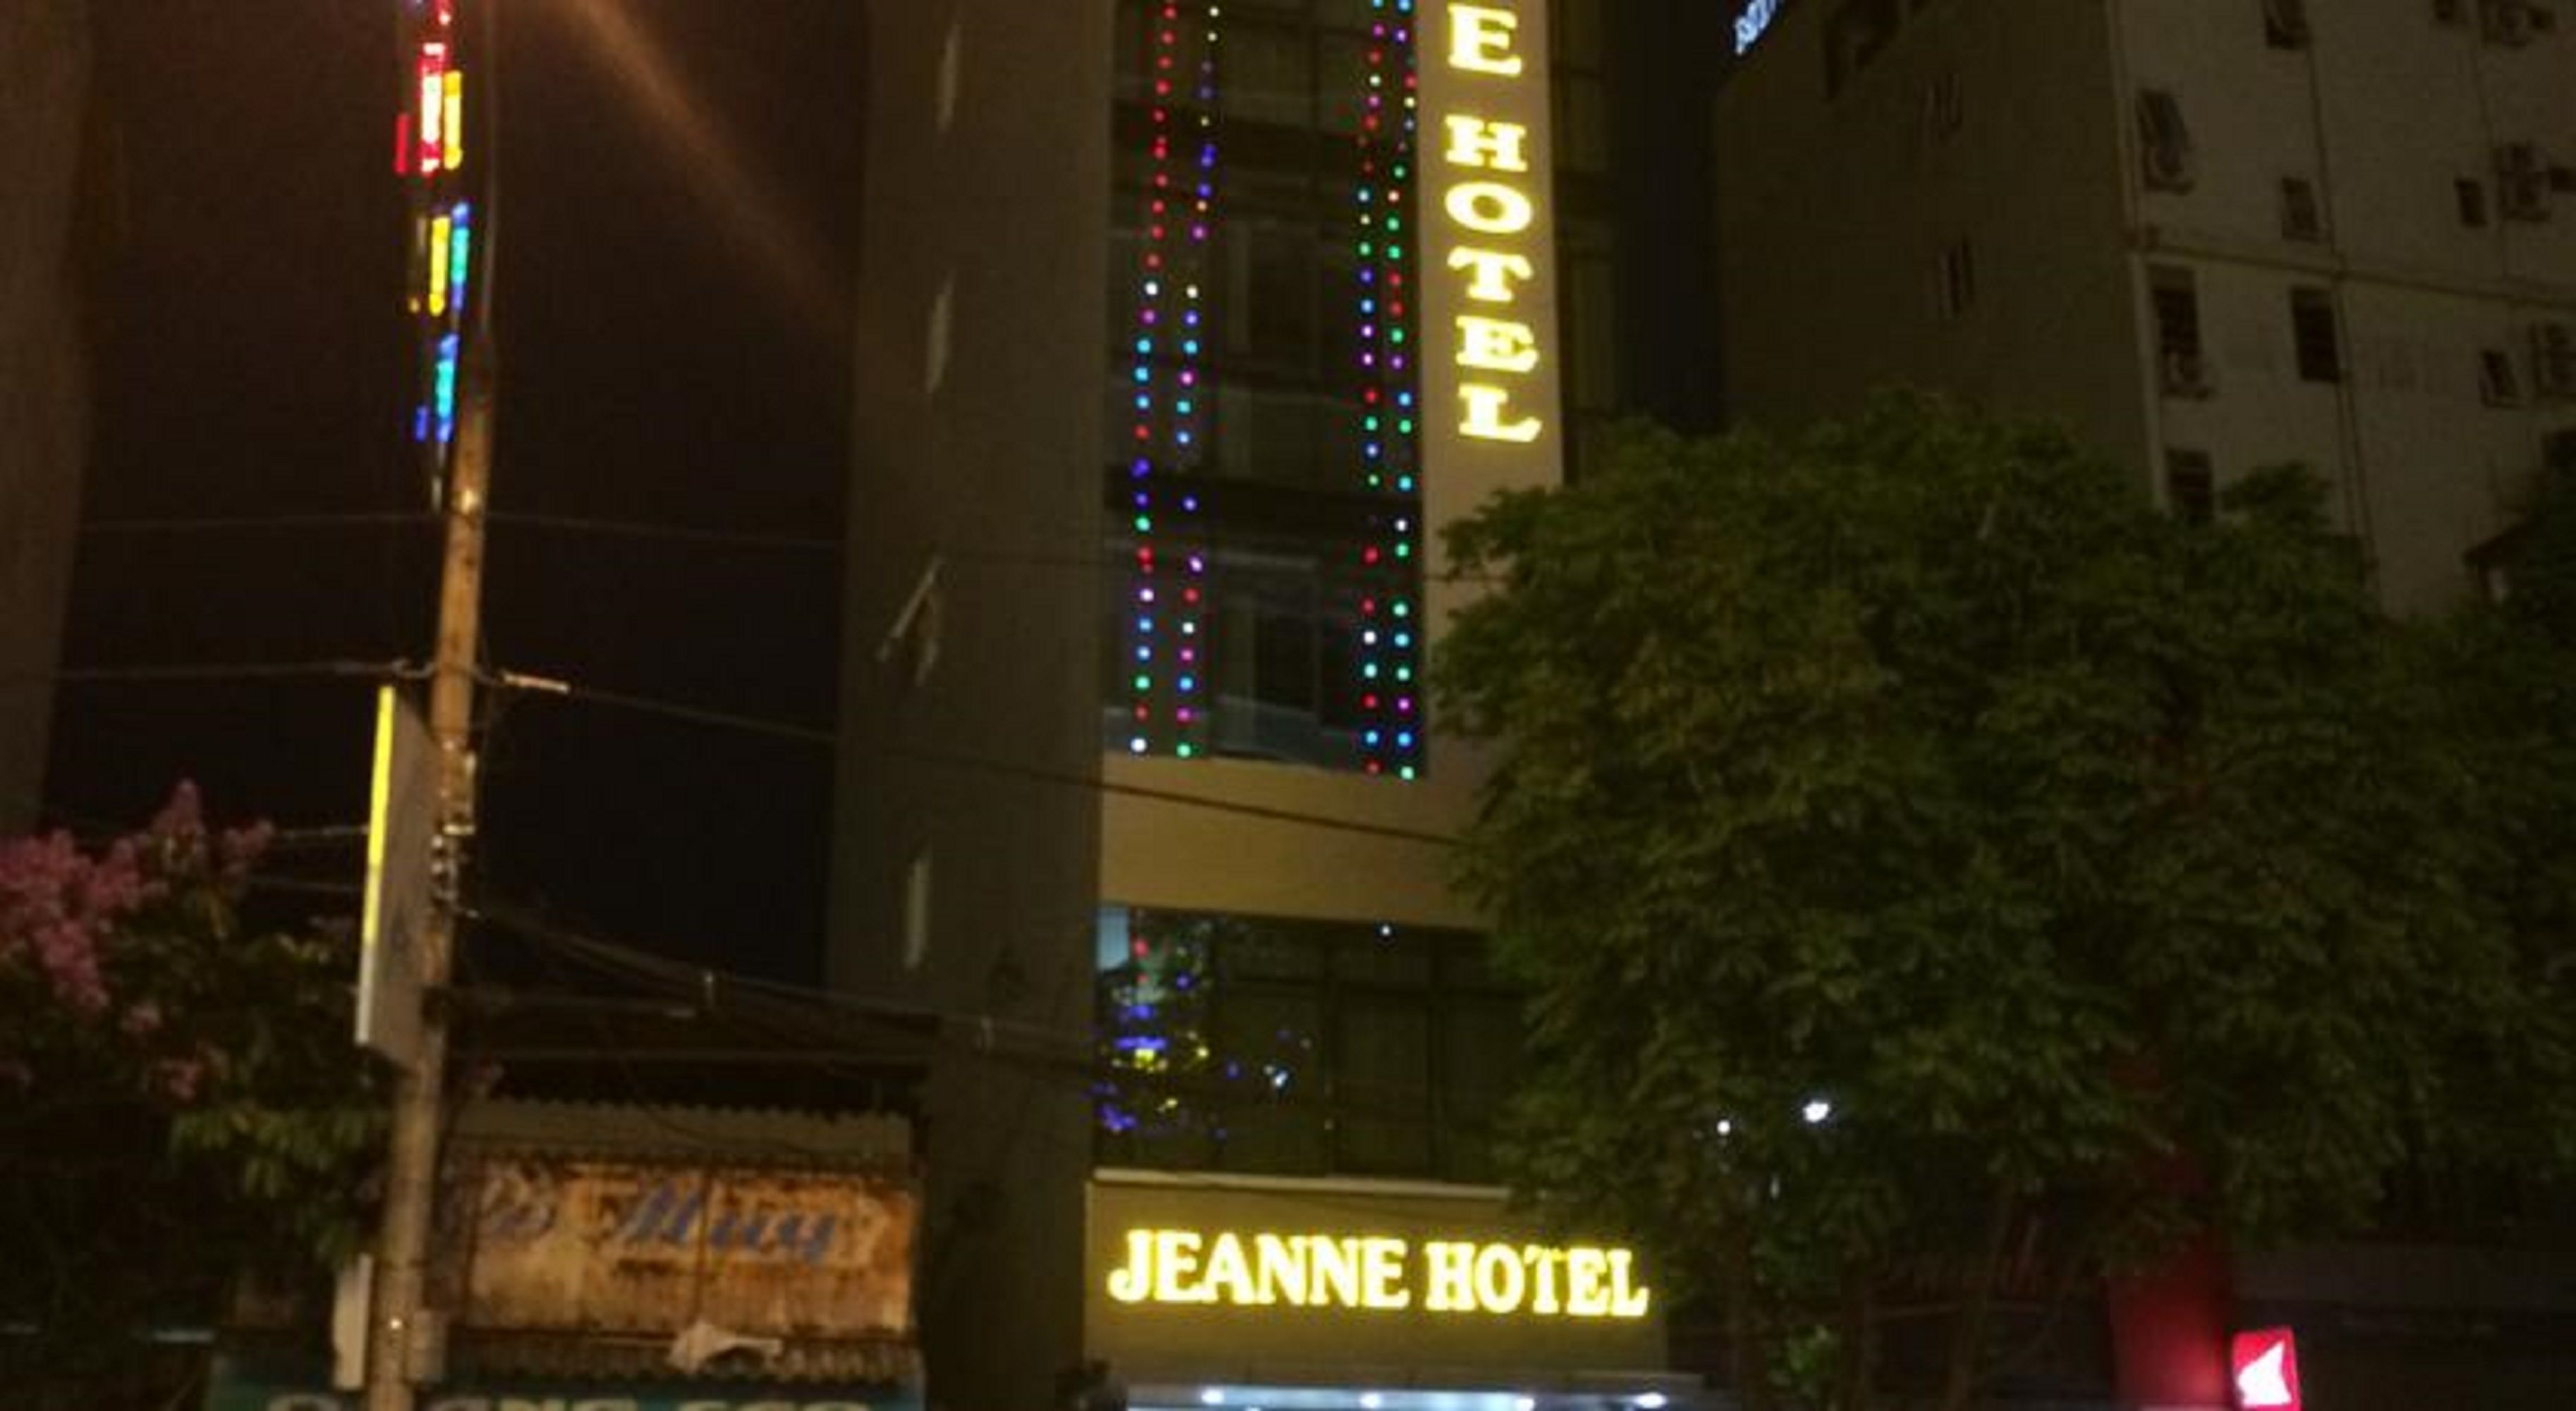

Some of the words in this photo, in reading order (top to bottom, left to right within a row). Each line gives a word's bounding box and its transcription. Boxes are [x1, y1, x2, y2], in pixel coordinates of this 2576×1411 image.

[1444, 114, 1541, 442] HOTEL
[1107, 1229, 1409, 1309] JEANNE
[1423, 1241, 1649, 1316] HOTEL
